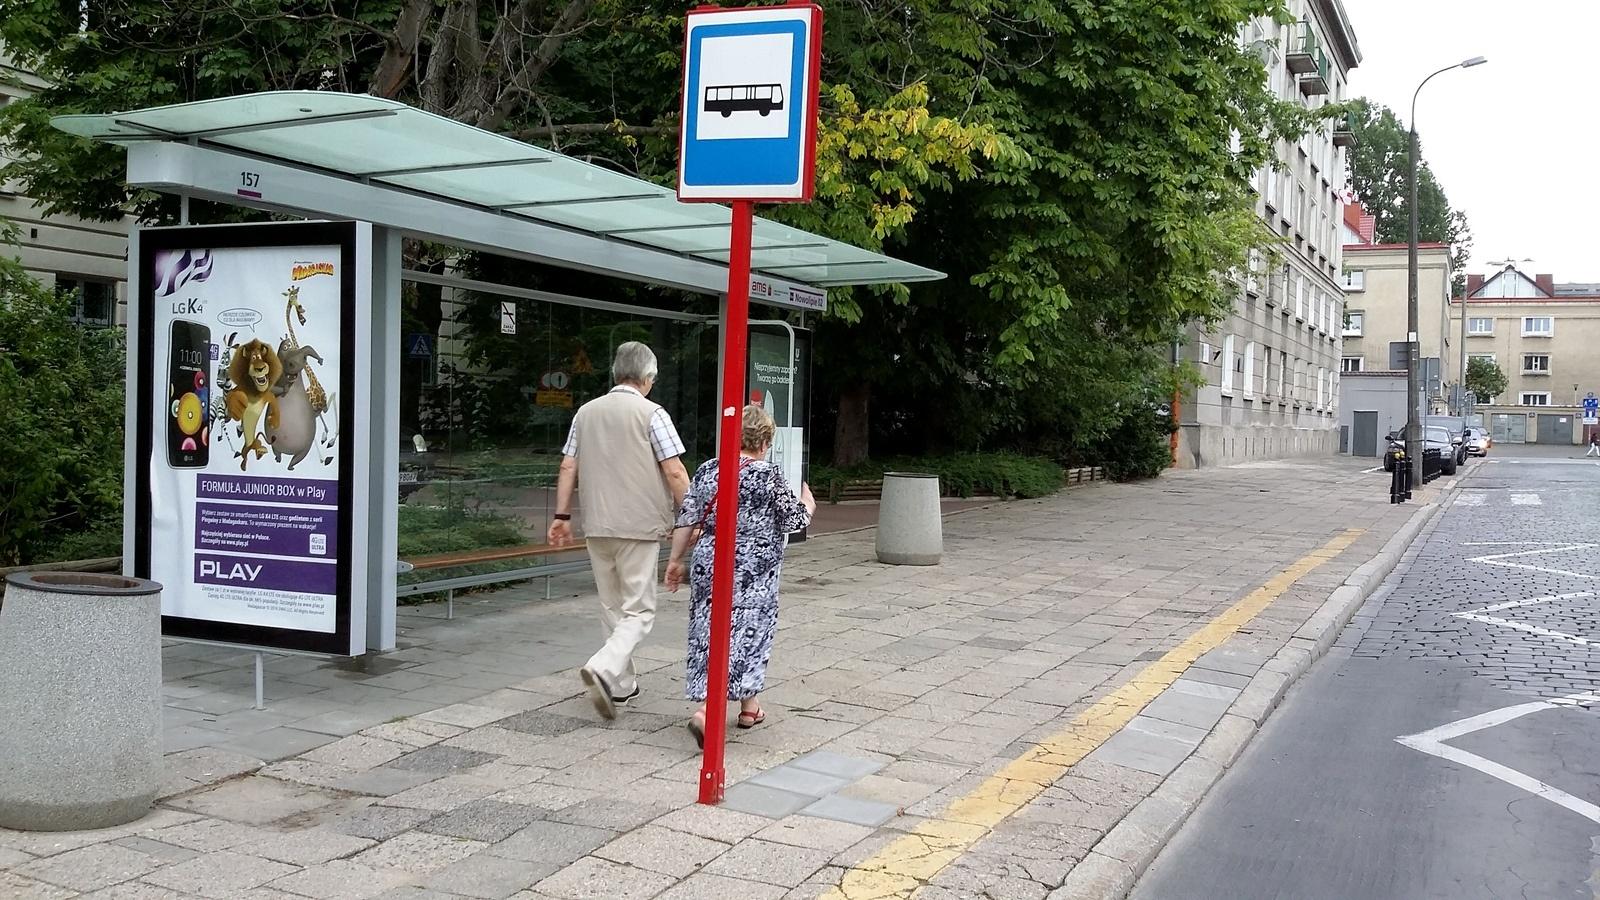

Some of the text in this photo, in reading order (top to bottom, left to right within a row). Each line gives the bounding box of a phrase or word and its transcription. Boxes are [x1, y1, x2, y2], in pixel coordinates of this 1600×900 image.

[241, 171, 260, 188] 157
[752, 281, 766, 293] ams
[172, 298, 203, 314] LG K4
[795, 293, 817, 307] Nowolipie
[180, 349, 202, 365] 11:00
[202, 480, 326, 500] FORMUŁA JUNIOR BOX w Play
[200, 560, 263, 581] PLAY
